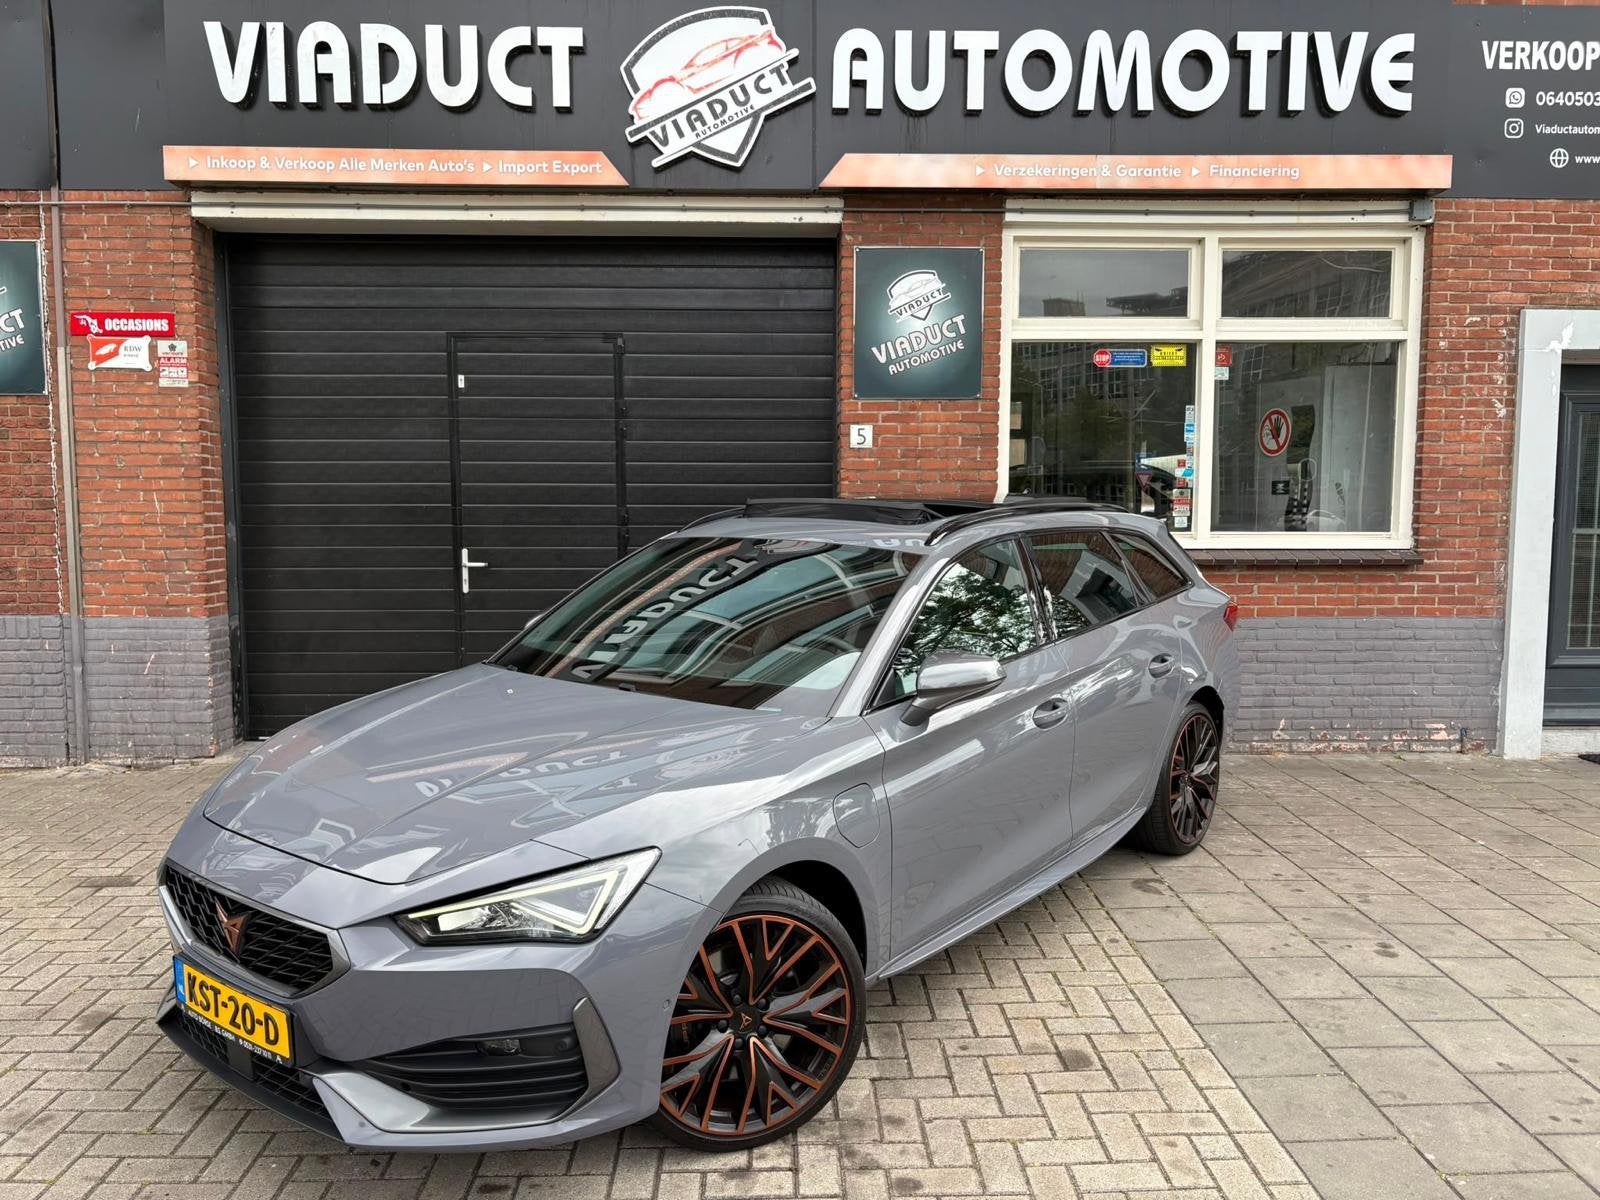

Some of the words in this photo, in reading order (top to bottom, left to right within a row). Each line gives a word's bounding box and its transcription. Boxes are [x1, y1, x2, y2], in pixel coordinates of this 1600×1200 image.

[203, 20, 584, 110] VIADUCT
[831, 28, 1416, 114] AUTOMOTIVE
[1481, 40, 1600, 71] VERKOOP
[649, 63, 789, 148] VIADUCT
[1535, 91, 1600, 107] 0640503
[695, 105, 755, 139] AUTOMOTIVE
[206, 155, 256, 173] Inkoop
[260, 157, 270, 169] &
[275, 157, 335, 172] Verkoop
[339, 158, 367, 171] Alle
[370, 159, 424, 173] Merken
[428, 160, 475, 173] Auto's
[498, 159, 549, 176] Import
[552, 160, 602, 176] Export
[994, 164, 1097, 179] Verzekeringen
[1101, 165, 1111, 177] &
[1116, 164, 1182, 178] Garantie
[1209, 164, 1300, 180] Financiering
[896, 288, 943, 317] VIADUCT
[104, 318, 169, 332] OCCASIONS
[871, 314, 967, 364] VIADUCT
[888, 339, 965, 376] AUTOMOTIVE
[856, 428, 867, 445] 5
[187, 972, 280, 1046] KST-20-D
